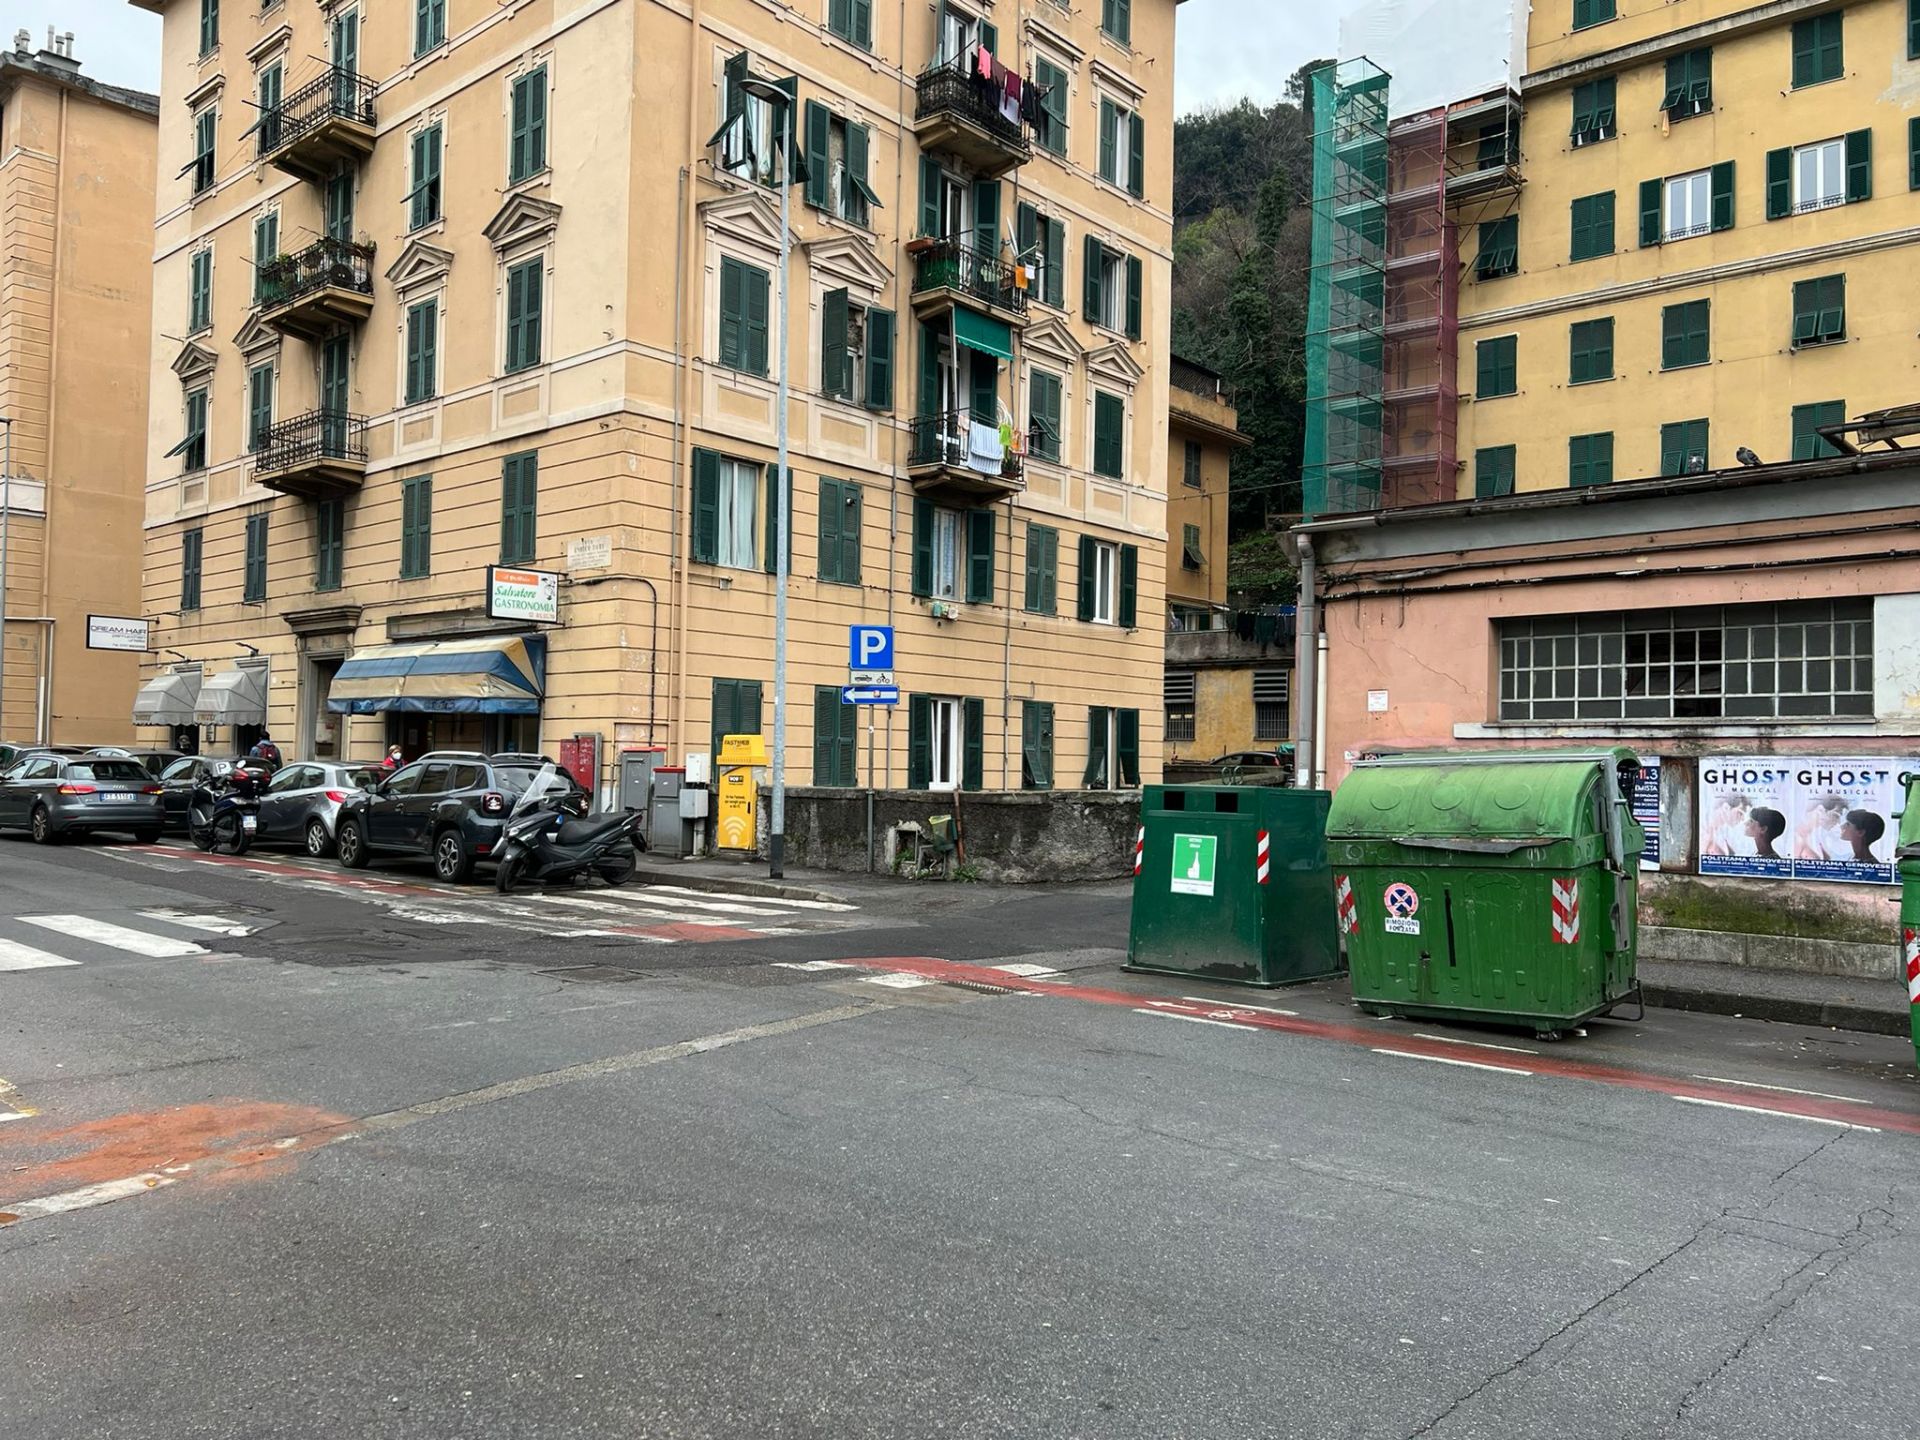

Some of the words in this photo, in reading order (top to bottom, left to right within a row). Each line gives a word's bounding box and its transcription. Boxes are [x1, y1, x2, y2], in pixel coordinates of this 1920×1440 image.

[494, 585, 537, 599] Salvatore
[494, 597, 555, 613] GASTRONOMIA
[90, 625, 124, 633] DREAM
[860, 629, 887, 665] P
[1703, 769, 1790, 785] GHOST
[1797, 770, 1889, 786] GHOST
[1795, 859, 1844, 867] POLITEAMA
[1386, 919, 1419, 927] RIMOZIONE
